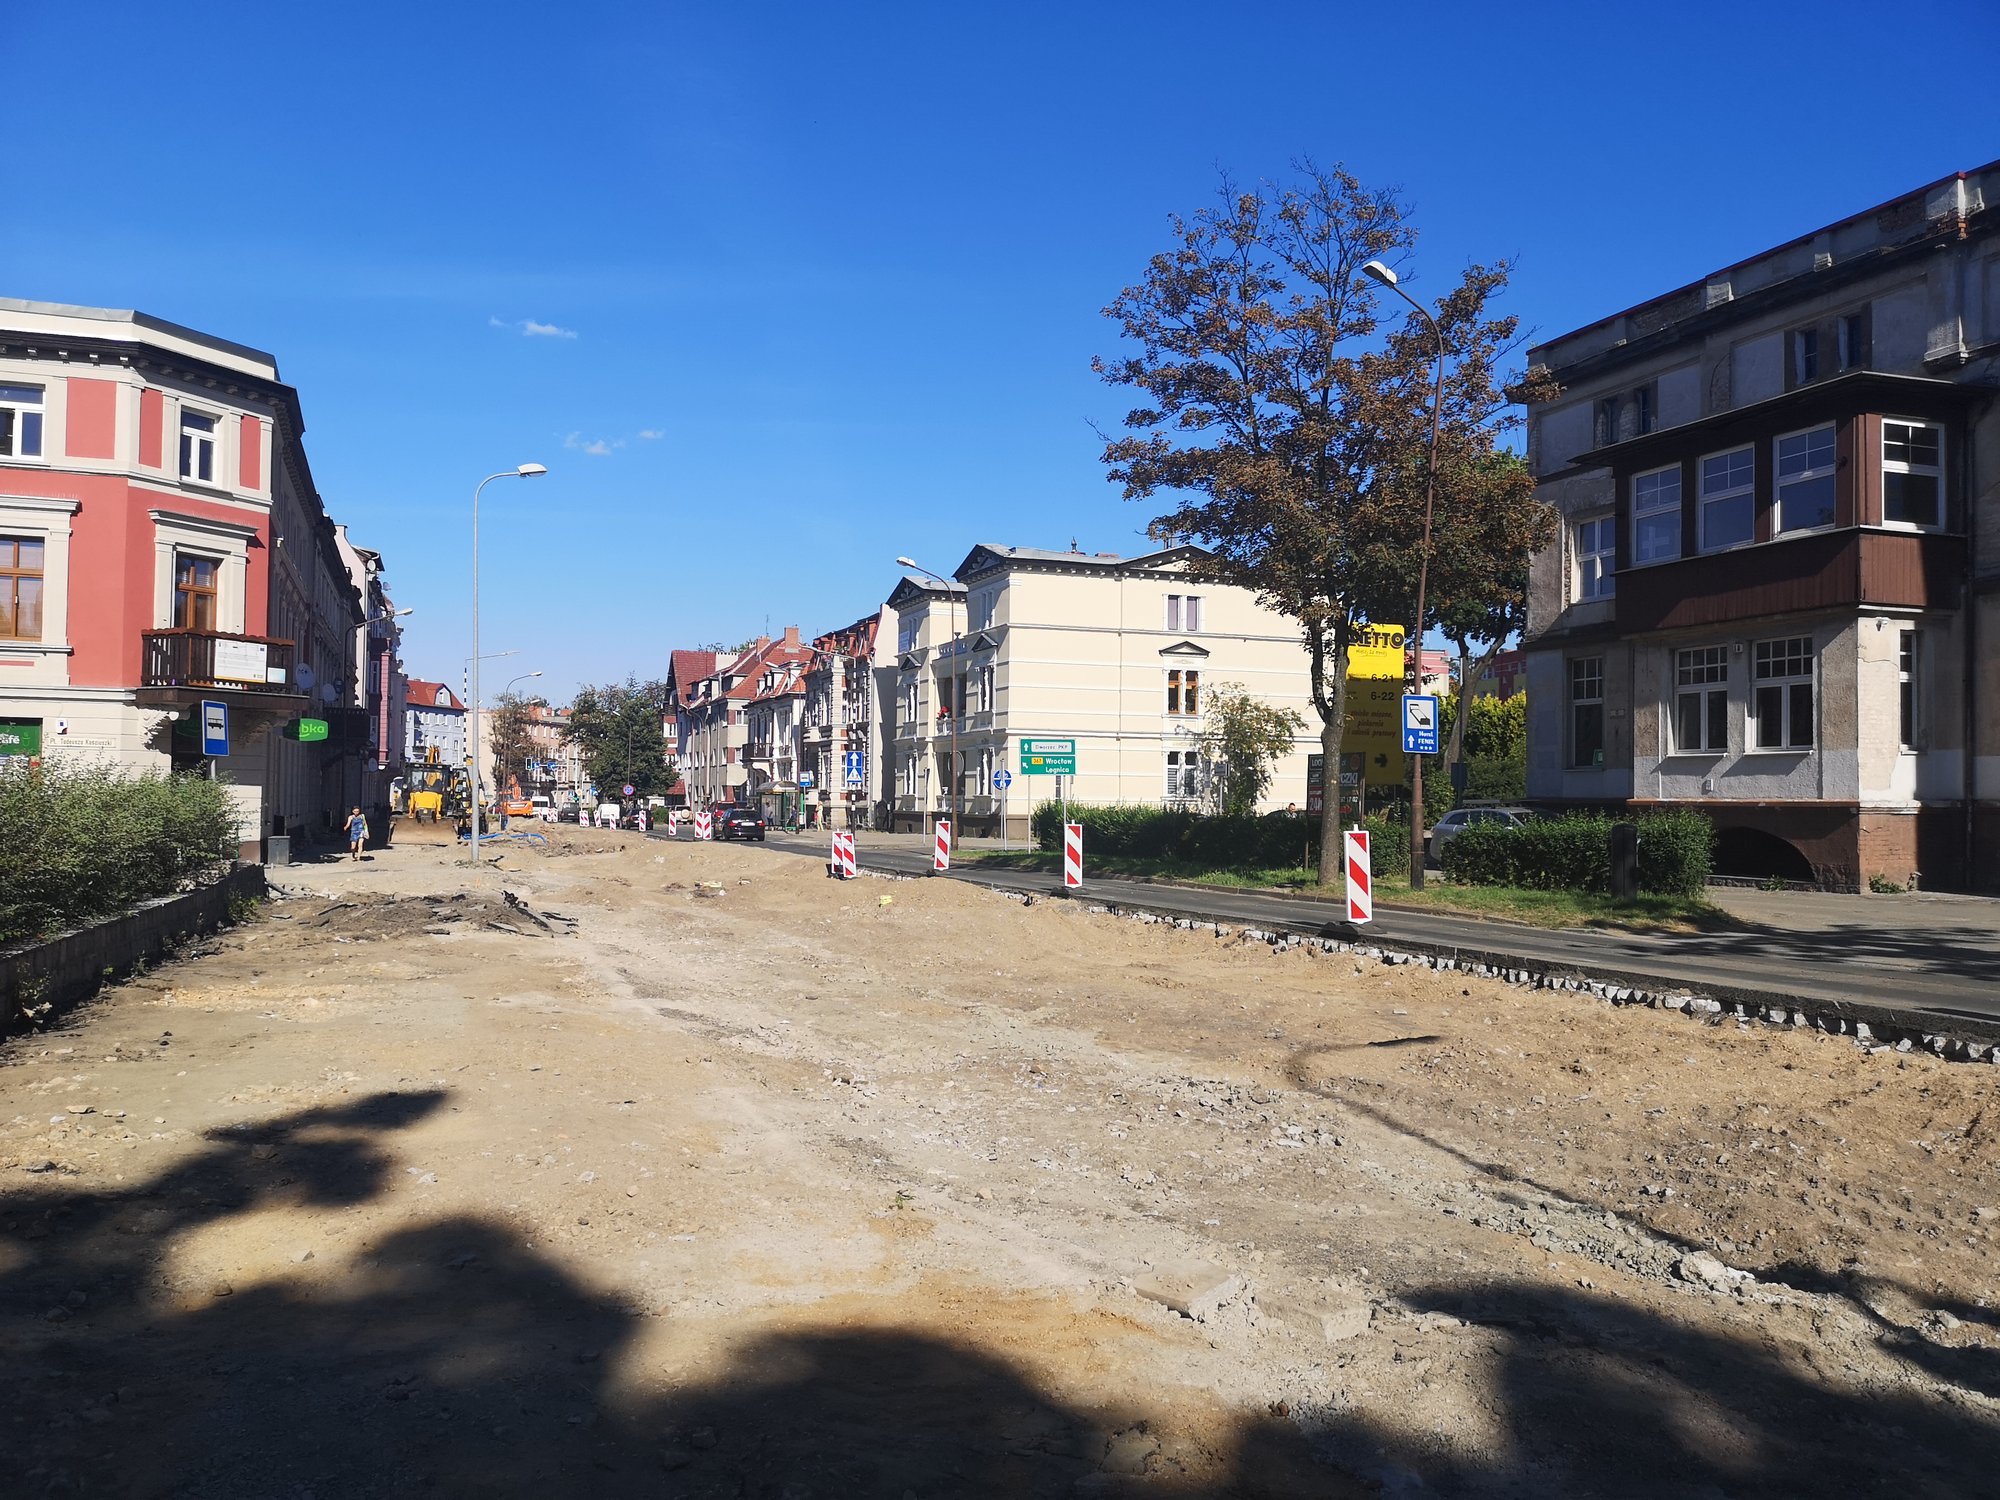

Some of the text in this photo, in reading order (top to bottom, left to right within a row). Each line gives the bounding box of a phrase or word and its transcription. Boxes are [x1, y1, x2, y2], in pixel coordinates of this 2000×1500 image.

[1371, 674, 1394, 682] 6-21
[1371, 691, 1394, 700] 6-22
[1045, 757, 1072, 765] Wrocław
[1045, 766, 1069, 774] Legnica
